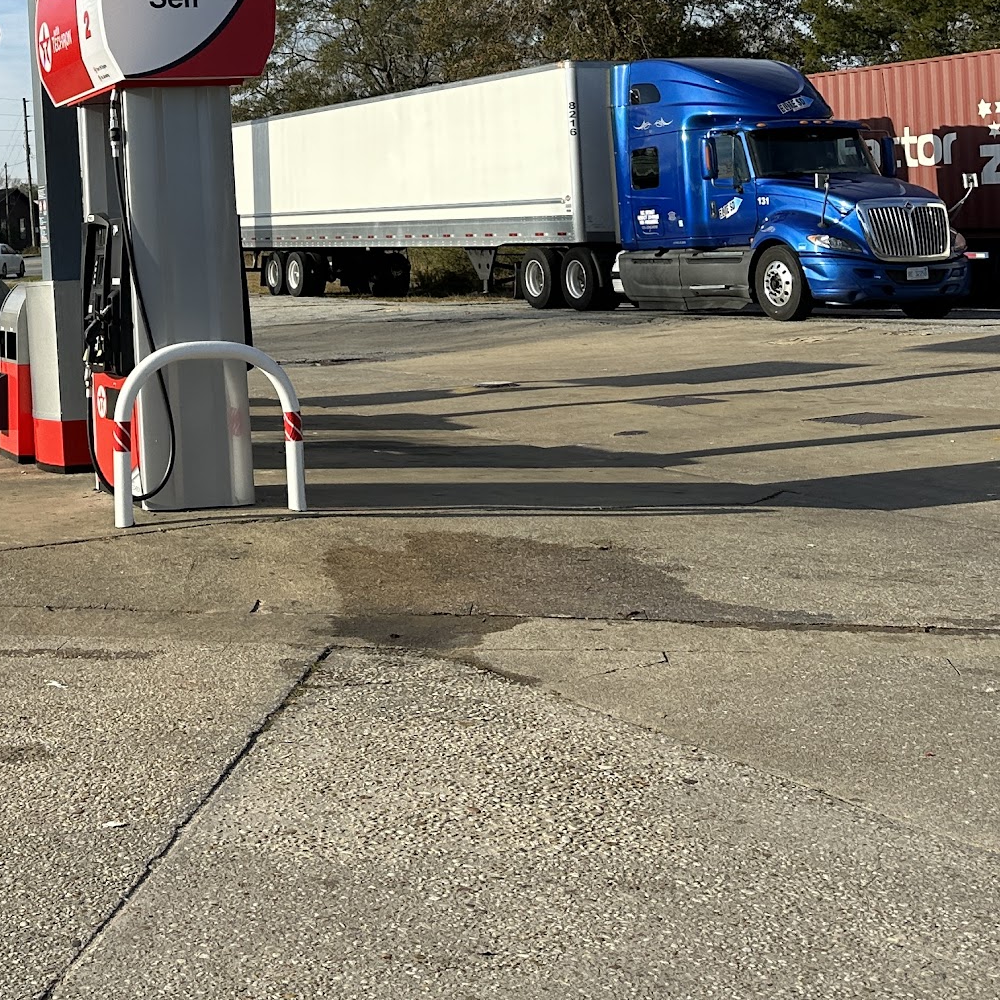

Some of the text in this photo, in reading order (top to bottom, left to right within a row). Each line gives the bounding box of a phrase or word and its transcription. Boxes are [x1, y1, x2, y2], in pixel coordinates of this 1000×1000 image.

[83, 10, 92, 40] 2
[568, 101, 577, 136] 8216
[757, 196, 770, 206] 131
